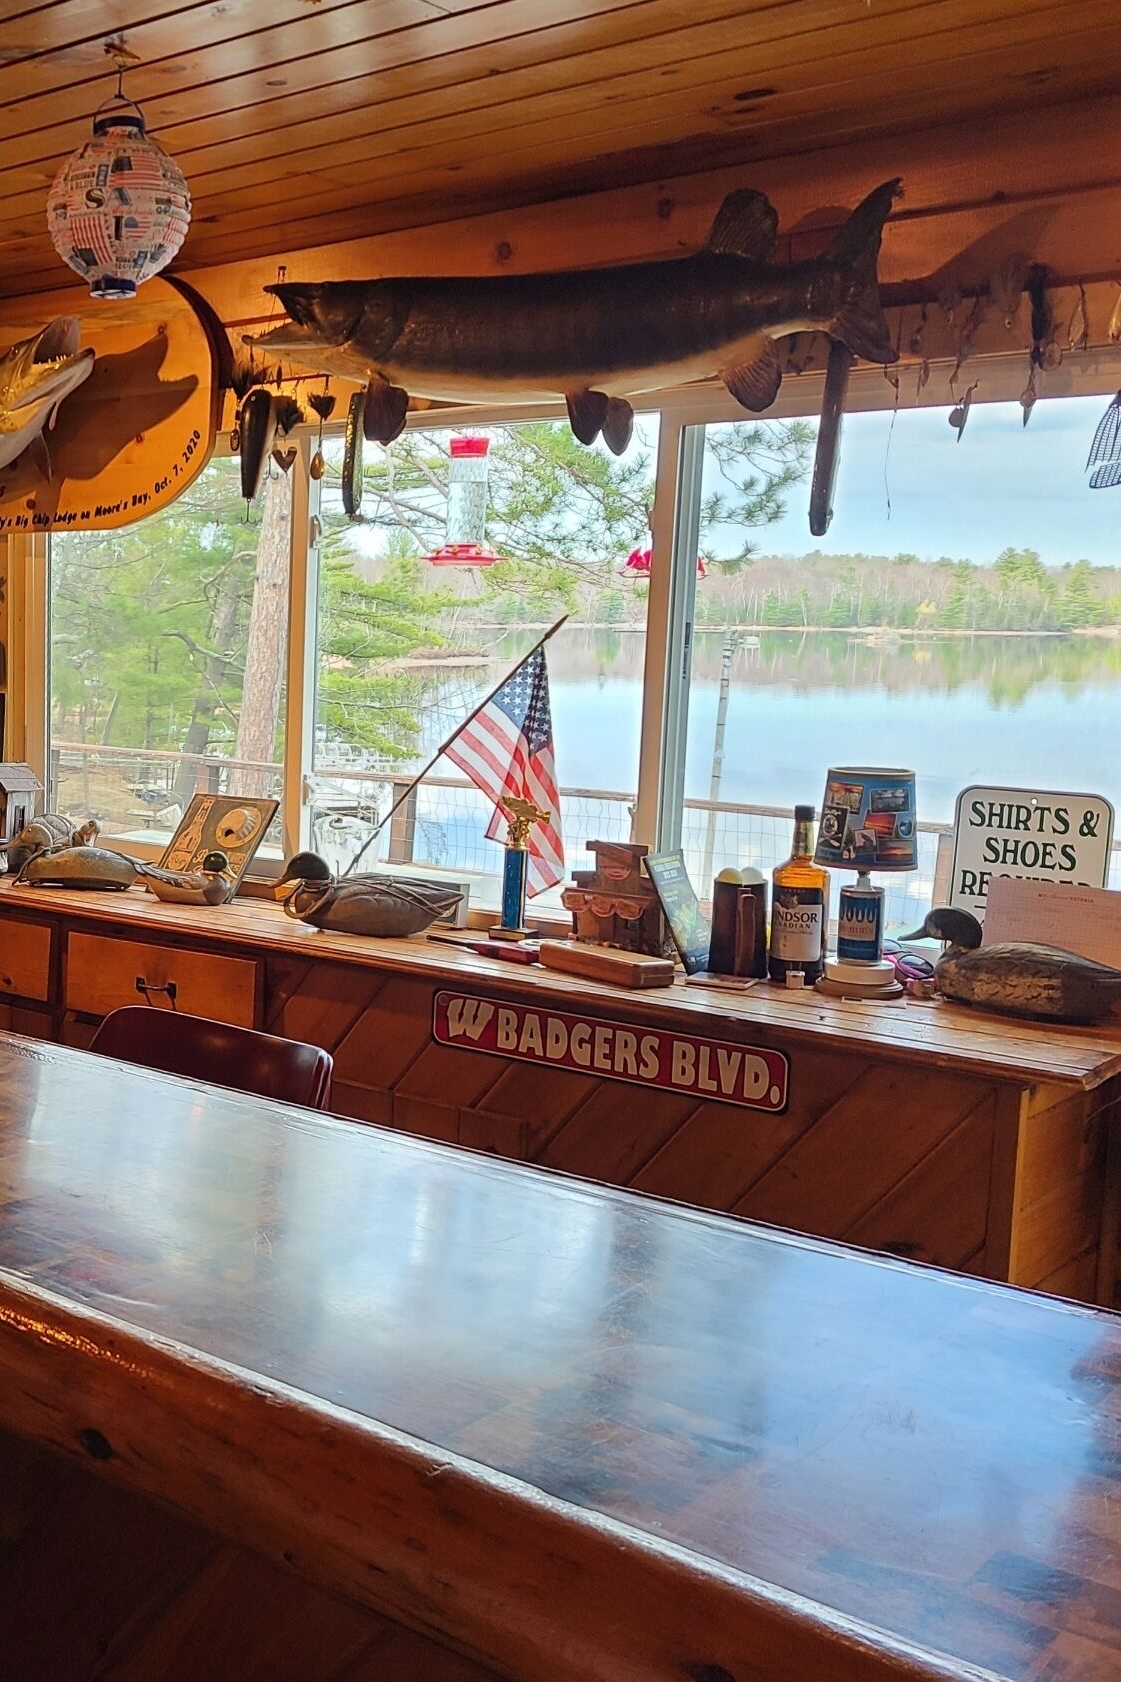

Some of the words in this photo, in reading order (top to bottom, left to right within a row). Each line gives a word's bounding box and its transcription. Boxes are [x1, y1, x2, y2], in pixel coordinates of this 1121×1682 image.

[15, 514, 29, 529] Big
[32, 512, 50, 526] Chip
[53, 510, 78, 525] Lodge
[81, 510, 90, 519] on
[94, 499, 128, 517] Moore's
[132, 491, 151, 507] Bay,
[154, 478, 172, 494] Oct.
[172, 464, 184, 477] 7,
[182, 429, 201, 463] 2020
[968, 800, 1070, 835] SHIRTS
[1079, 810, 1100, 838] &
[982, 836, 1077, 872] SHOES
[776, 911, 819, 923] NDSOR
[446, 999, 494, 1041] W
[496, 1008, 660, 1080] BADGERS
[671, 1040, 781, 1105] BLVD.
